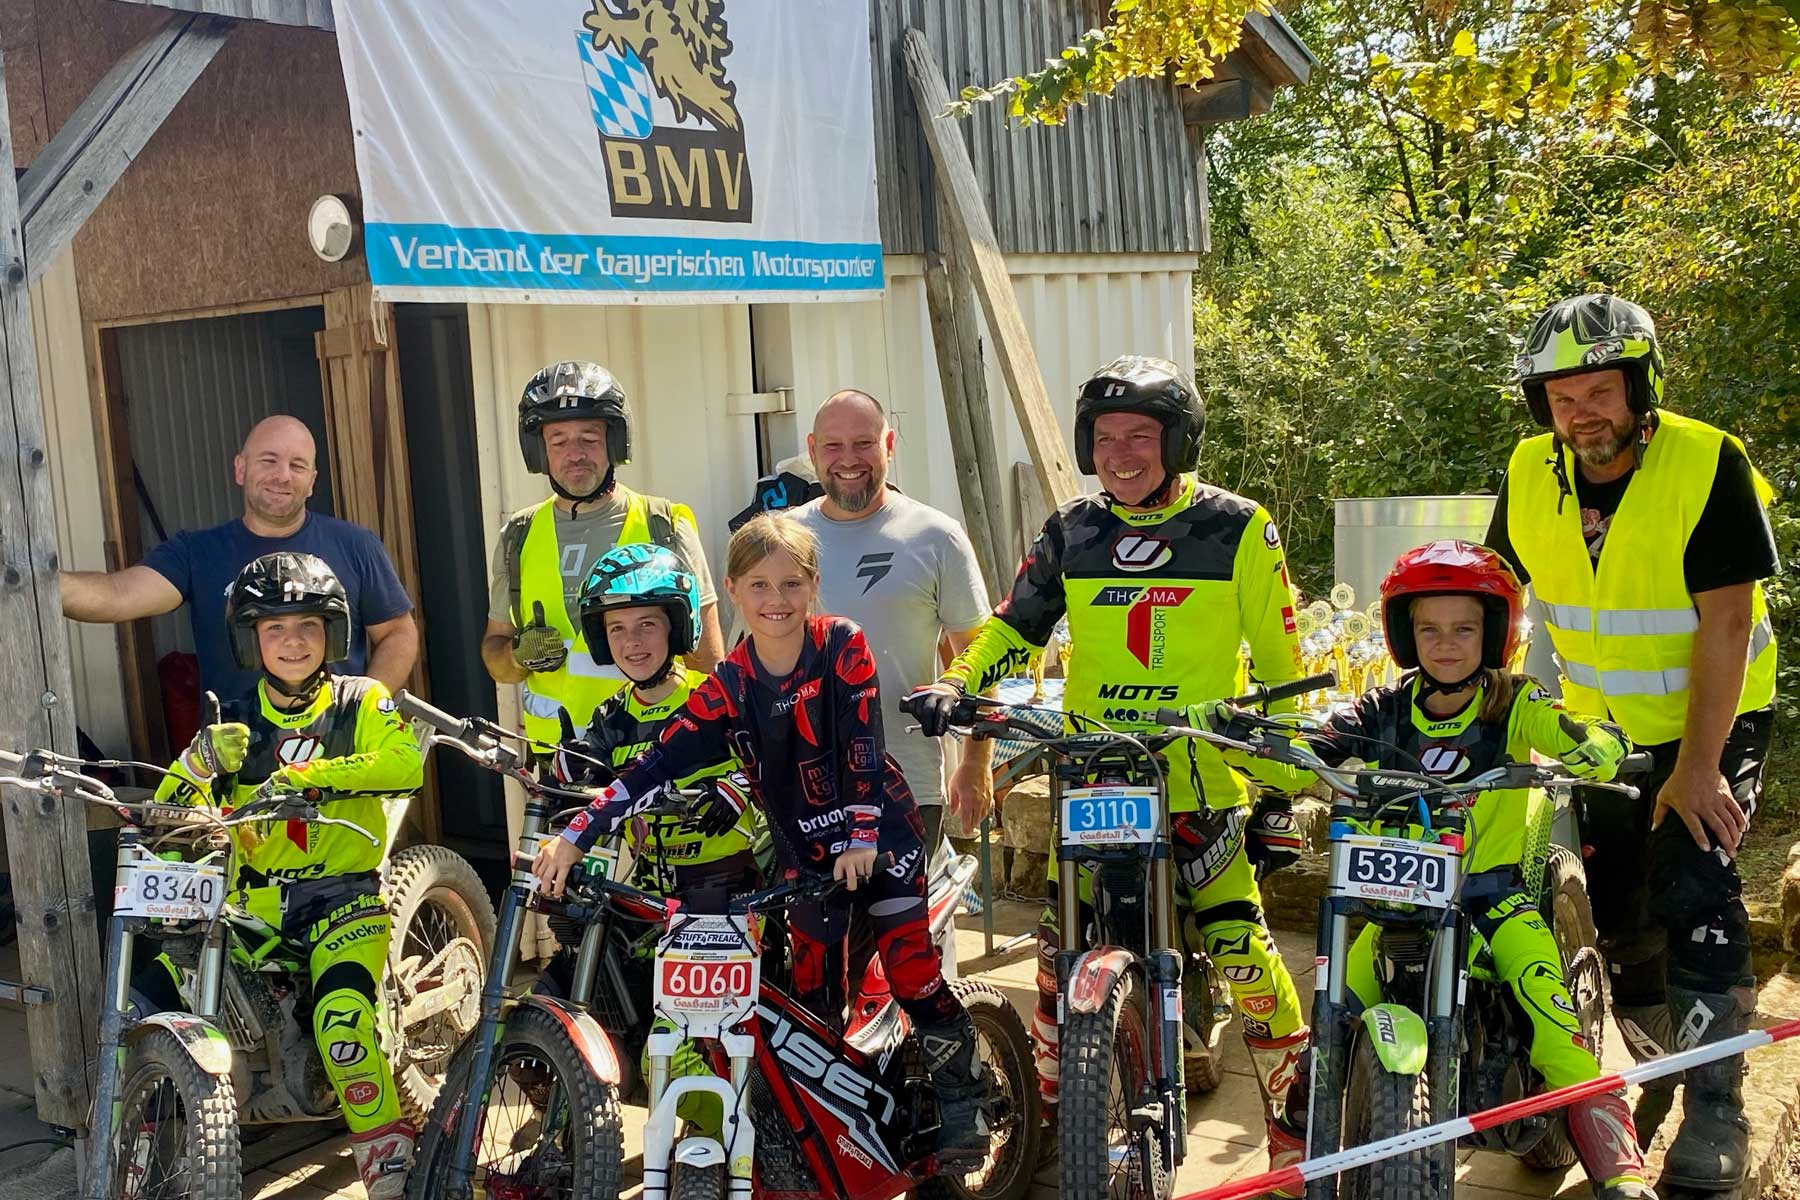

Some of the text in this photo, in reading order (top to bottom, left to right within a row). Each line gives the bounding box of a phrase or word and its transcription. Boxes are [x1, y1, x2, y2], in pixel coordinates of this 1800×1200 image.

[605, 142, 743, 211] BMV
[389, 235, 534, 273] Verband
[540, 246, 589, 275] der
[596, 247, 746, 284] bayerischen
[1106, 590, 1178, 603] THOMA
[1152, 607, 1167, 671] TRIALSPORT
[775, 685, 817, 712] THOMA
[1098, 683, 1180, 701] MOTS
[282, 712, 313, 724] MOTS
[1427, 722, 1463, 732] MOTS
[1080, 800, 1139, 829] 3110
[265, 859, 328, 879] MOTS
[1356, 850, 1439, 889] 5320
[142, 874, 213, 904] 8340
[325, 922, 387, 951] bruckner
[669, 963, 747, 996] 6060
